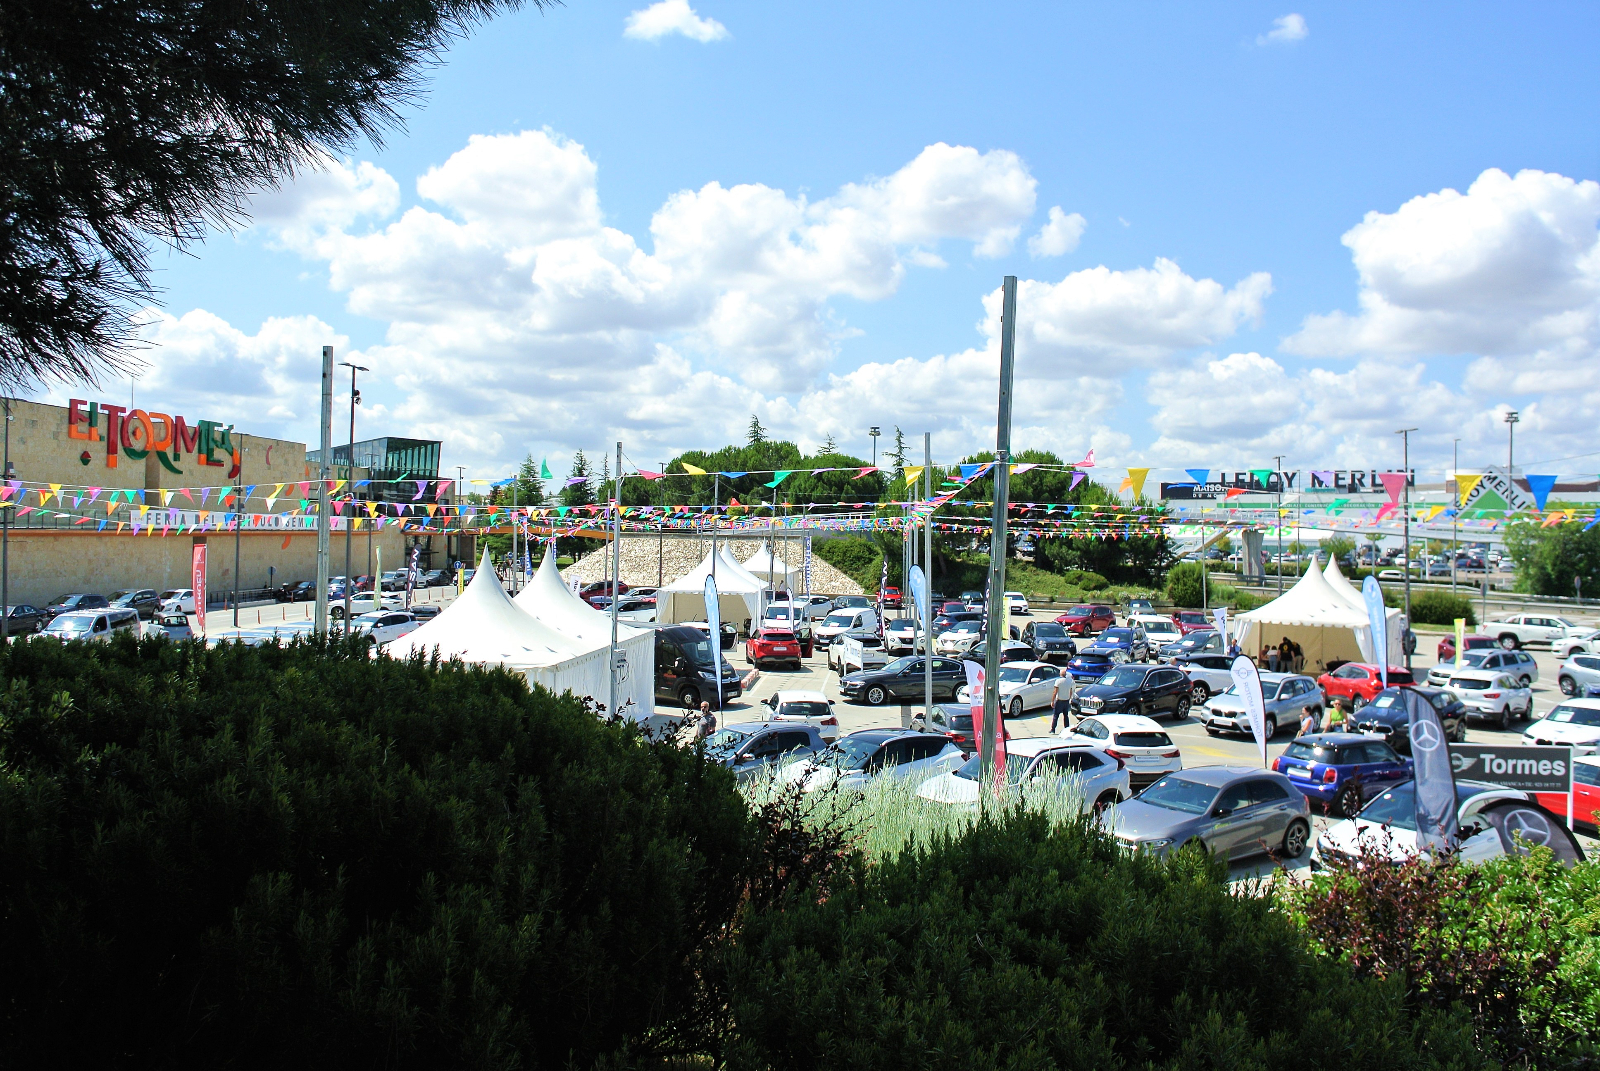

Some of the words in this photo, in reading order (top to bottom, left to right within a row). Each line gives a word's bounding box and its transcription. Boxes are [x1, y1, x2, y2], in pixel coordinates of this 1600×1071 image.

[100, 403, 240, 479] TORMES
[1484, 471, 1526, 510] MERLI
[1479, 753, 1566, 776] Tormes
